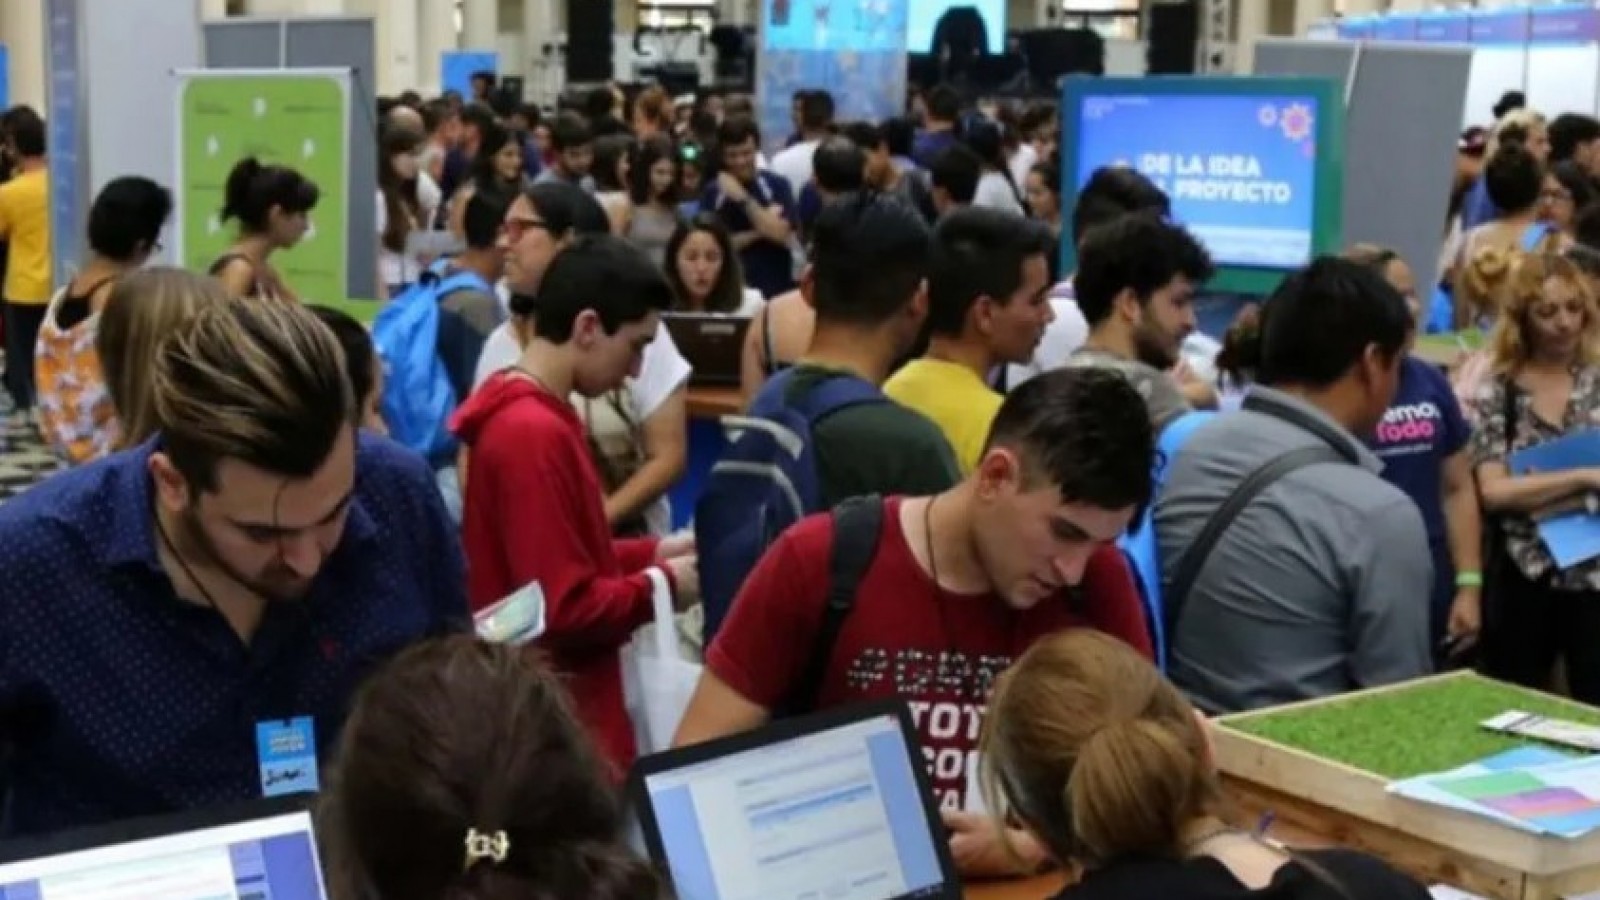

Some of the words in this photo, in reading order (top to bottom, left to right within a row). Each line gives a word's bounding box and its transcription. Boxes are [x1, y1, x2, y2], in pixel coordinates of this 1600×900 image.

[1175, 154, 1204, 177] LA
[1208, 155, 1262, 178] IDEA
[1174, 179, 1291, 204] PROYECTO
